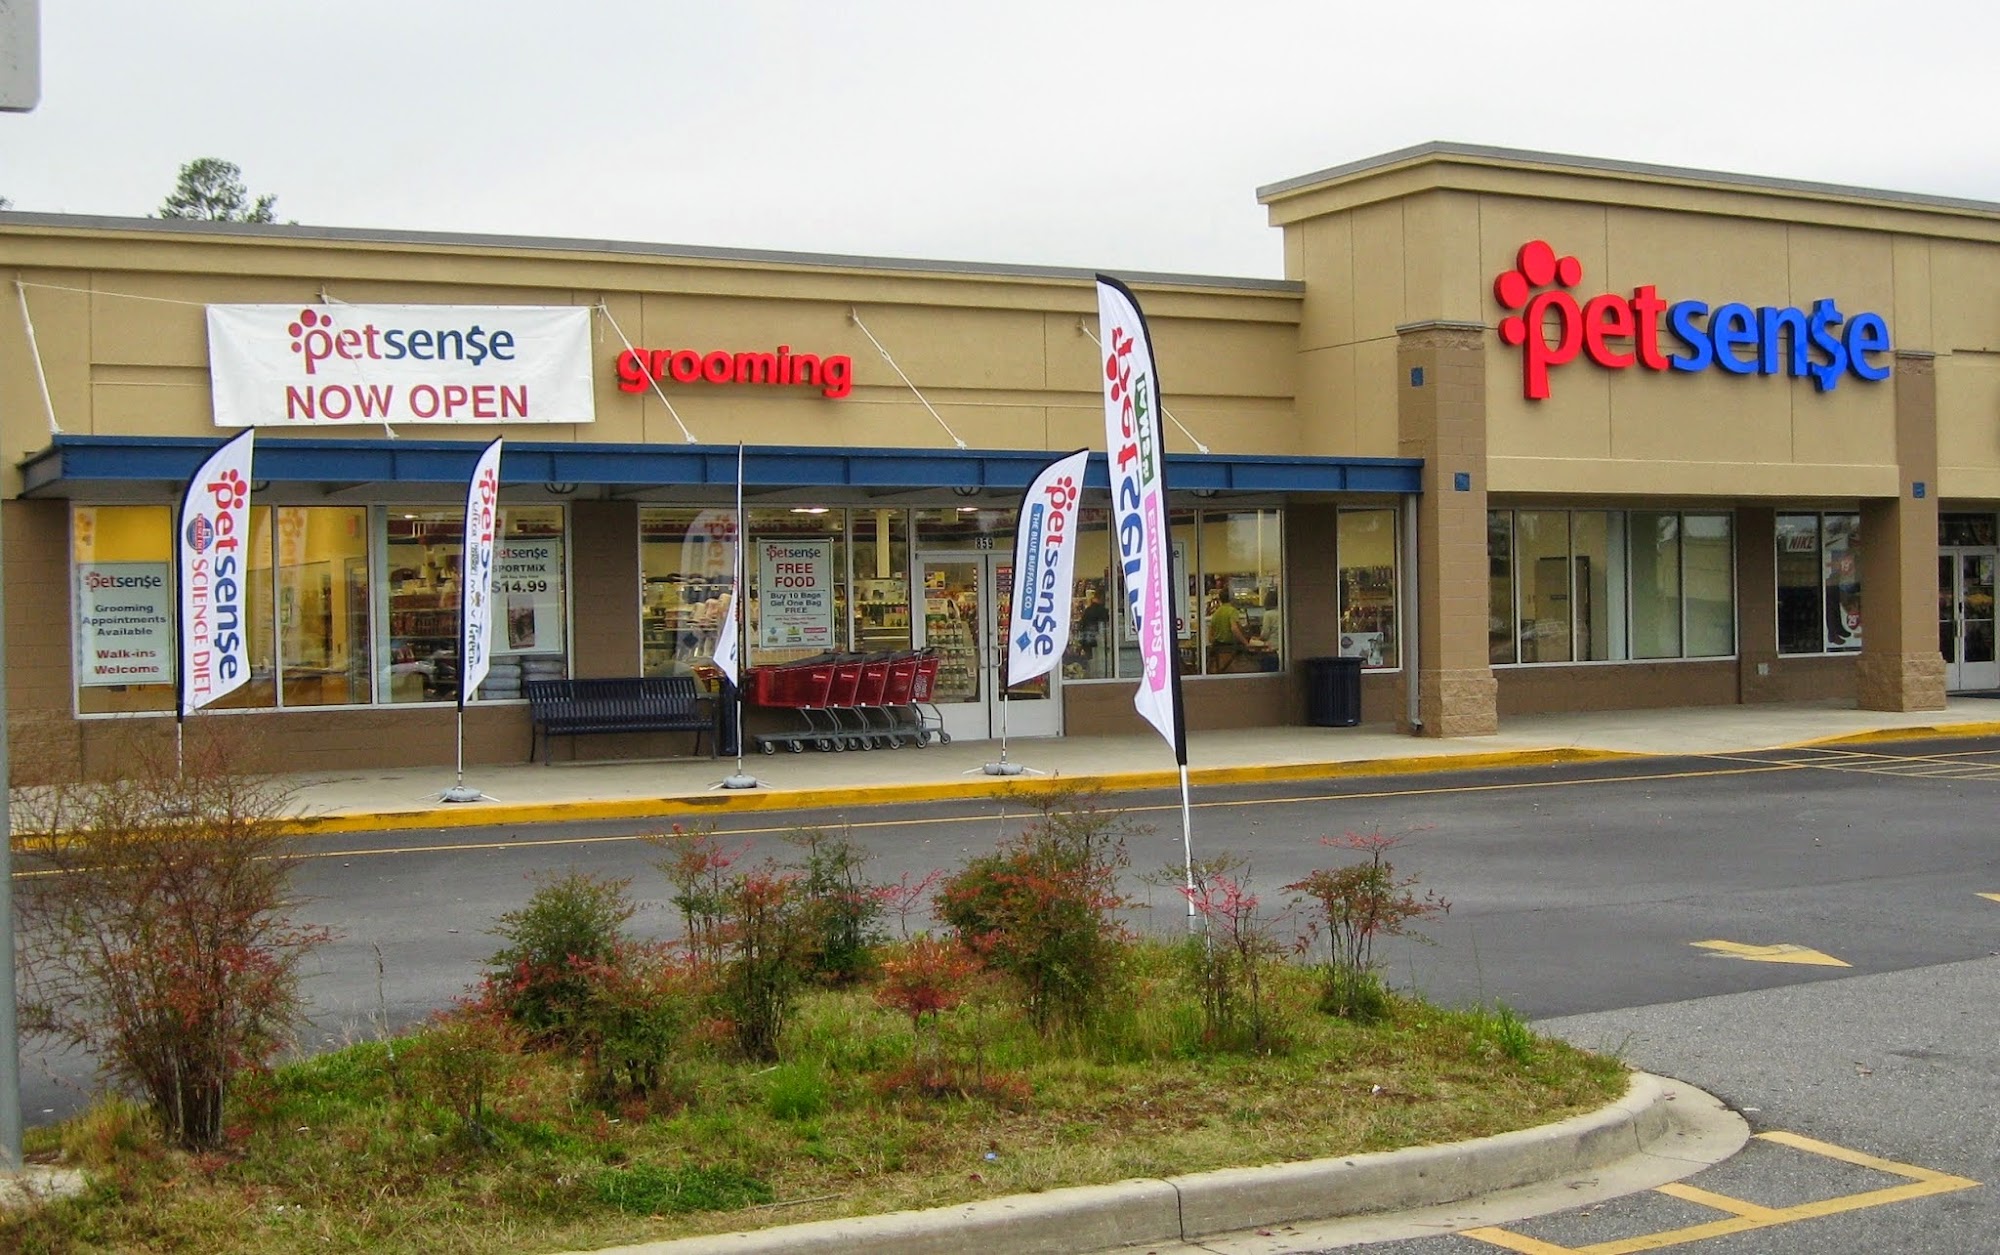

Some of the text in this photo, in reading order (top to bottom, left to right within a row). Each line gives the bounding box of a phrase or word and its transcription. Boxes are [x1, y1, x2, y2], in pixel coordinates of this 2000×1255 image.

[616, 344, 852, 399] grooming
[286, 384, 528, 419] NOW OPEN
[1031, 512, 1040, 530] THE
[976, 538, 993, 549] 859
[1029, 531, 1038, 553] BLUE
[1789, 535, 1815, 549] NIKE
[776, 563, 813, 574] FREE
[1026, 555, 1036, 594] BUFFALO
[774, 576, 815, 587] FOOD
[95, 604, 154, 613] Grooming
[82, 615, 167, 627] Appointments
[192, 559, 212, 694] SCIENCE DIET
[97, 627, 153, 636] Available
[97, 648, 156, 659] Walk-ins
[94, 665, 159, 674] Welcome
